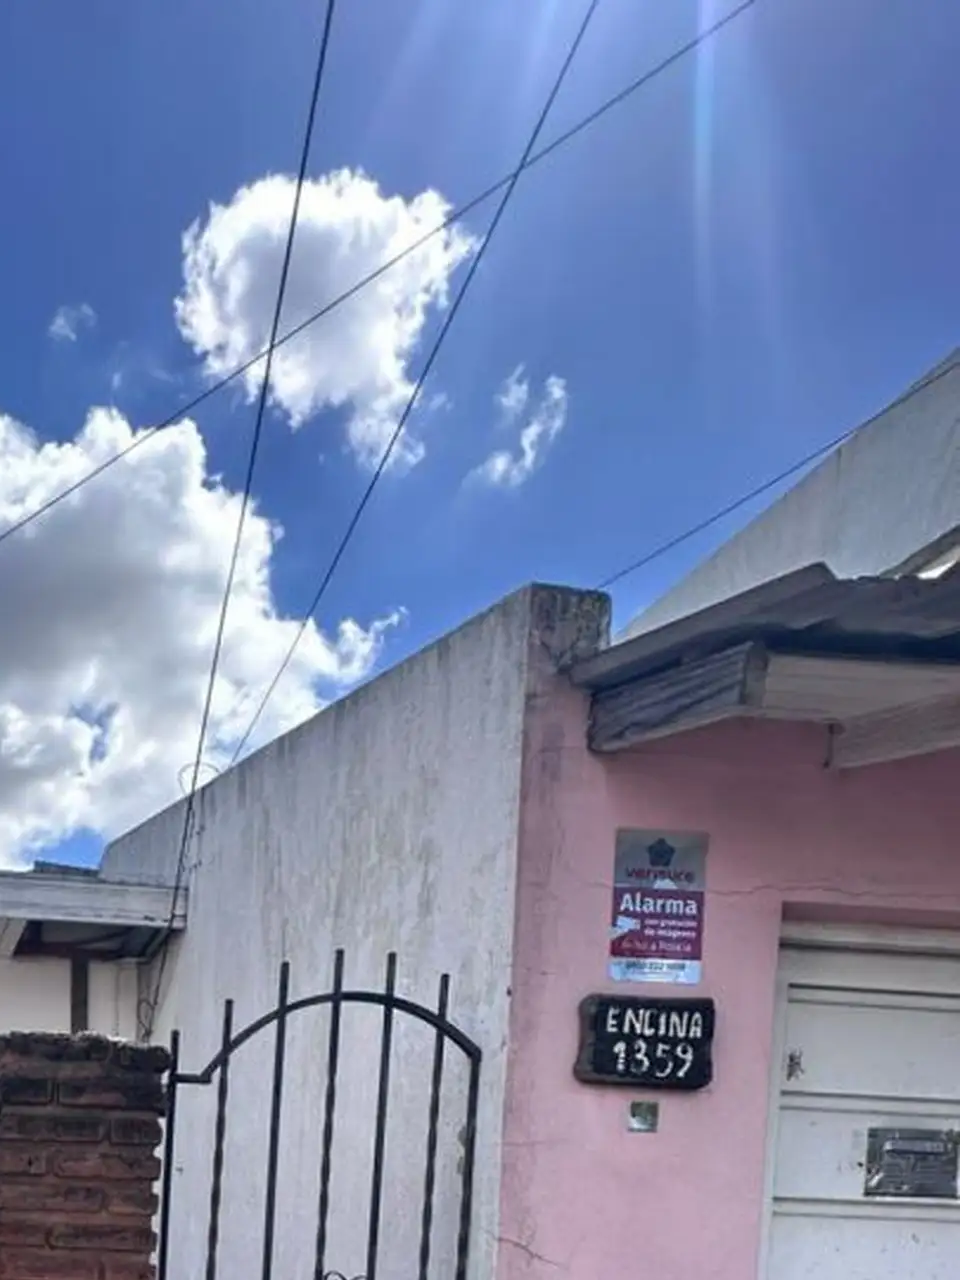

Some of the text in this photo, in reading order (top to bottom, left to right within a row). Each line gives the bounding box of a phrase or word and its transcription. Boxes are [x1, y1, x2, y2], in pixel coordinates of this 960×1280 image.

[619, 892, 698, 915] Alarma
[606, 1007, 703, 1039] ENCINA
[613, 1037, 694, 1078] 1359
